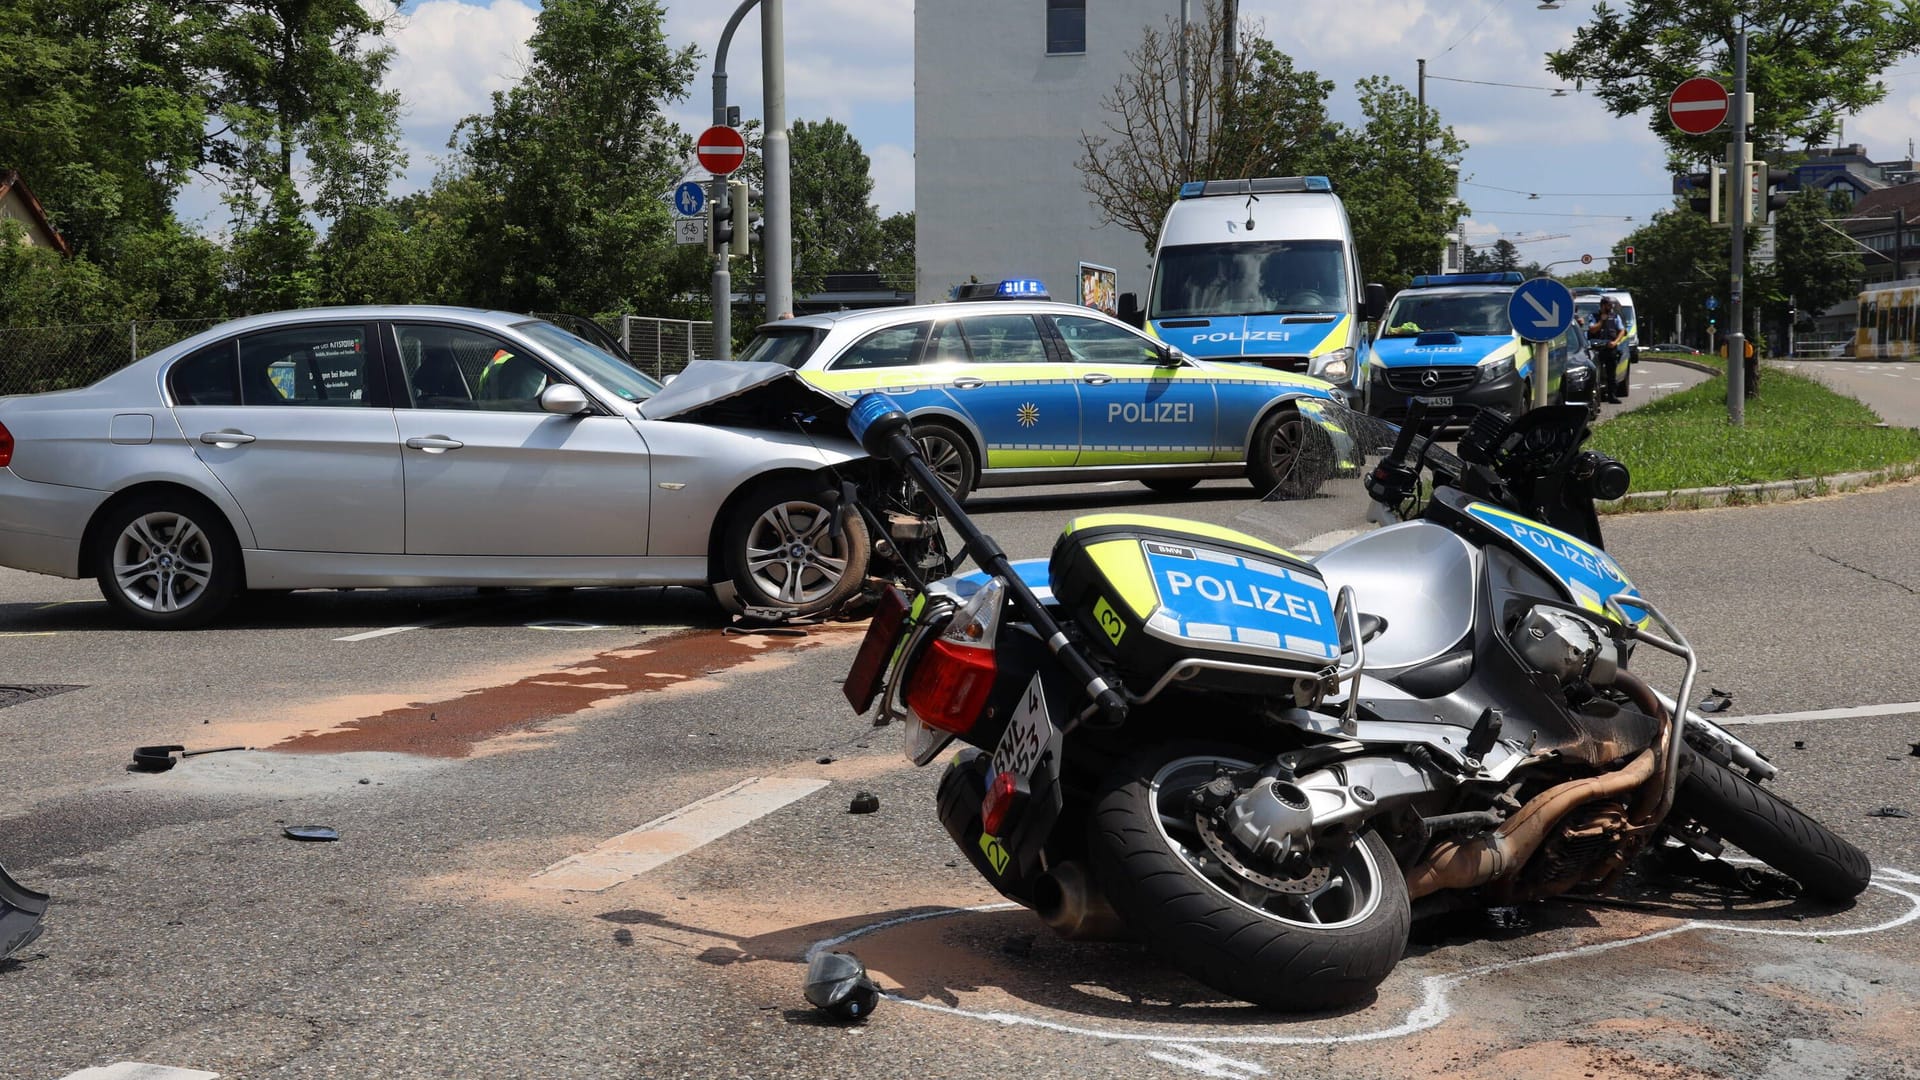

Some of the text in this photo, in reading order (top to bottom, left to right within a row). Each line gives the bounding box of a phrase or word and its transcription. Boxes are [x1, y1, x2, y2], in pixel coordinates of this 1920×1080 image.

[1192, 331, 1290, 345] POLIZEI
[1404, 346, 1464, 354] POLIZEI
[1107, 402, 1194, 423] POLIZEI
[1158, 545, 1183, 556] BMW
[1510, 522, 1604, 580] POLIZEI
[1165, 569, 1322, 626] POLIZEI
[1101, 608, 1121, 638] 3
[1028, 686, 1039, 715] 4
[987, 840, 1008, 871] 2
